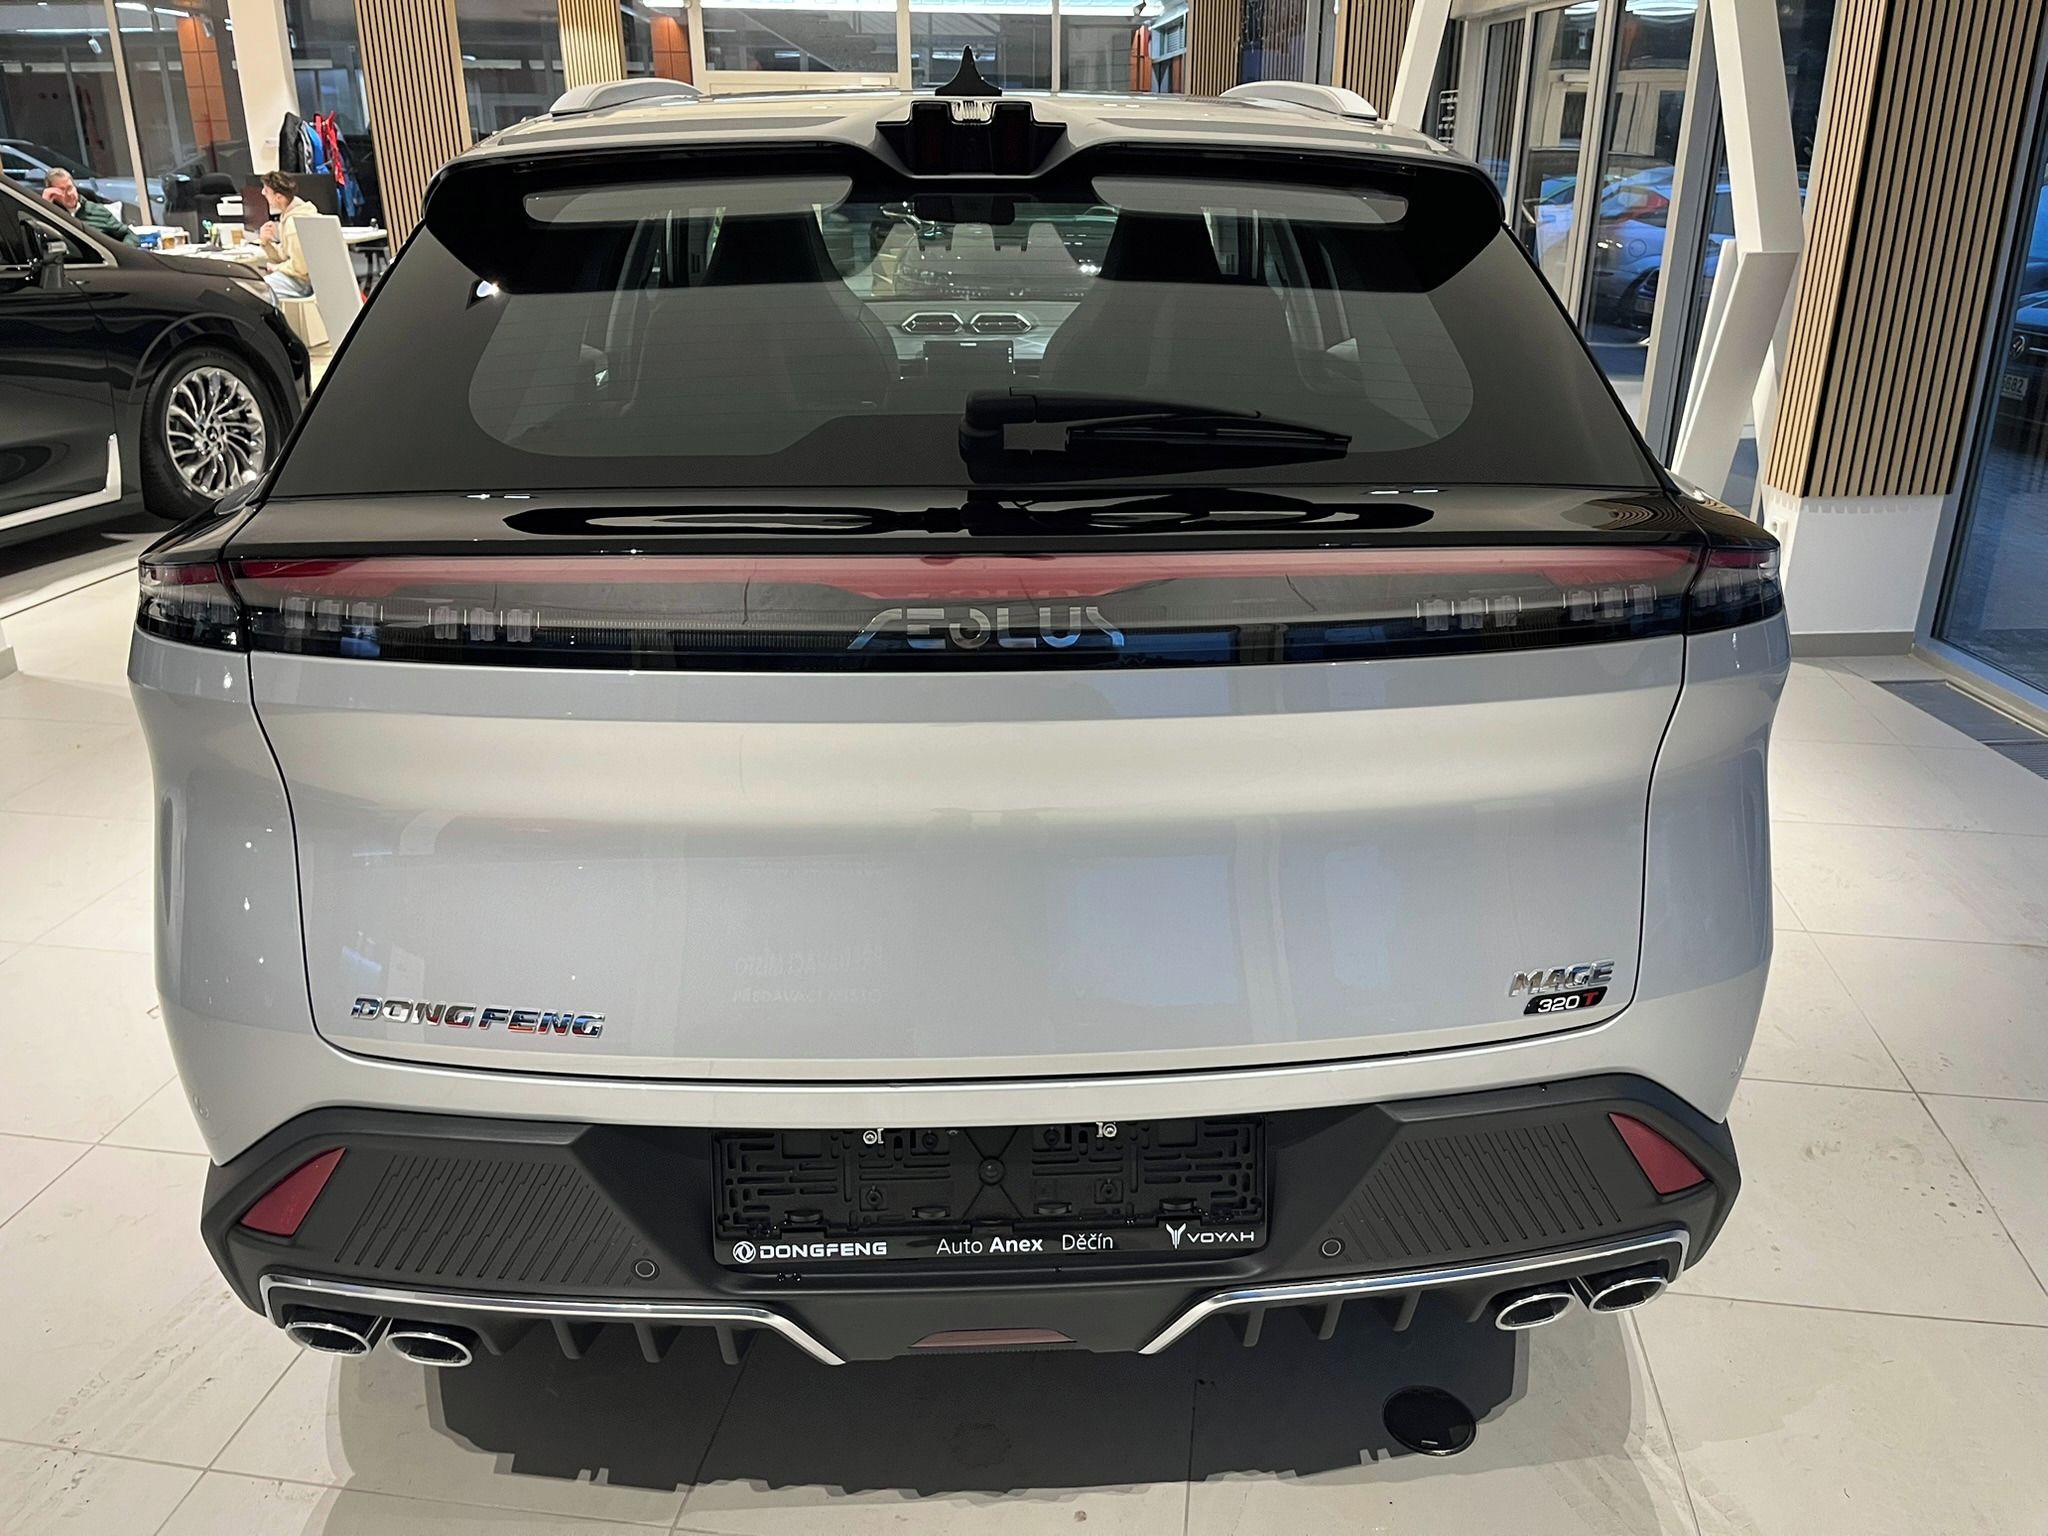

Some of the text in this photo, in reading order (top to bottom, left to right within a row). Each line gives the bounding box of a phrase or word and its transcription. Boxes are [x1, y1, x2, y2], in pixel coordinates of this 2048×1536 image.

[1508, 959, 1615, 997] MAGE
[350, 994, 606, 1038] DONGFENG
[936, 1232, 1113, 1255] Auto Anex Děčín
[1187, 1231, 1255, 1243] VOYAH
[759, 1241, 887, 1259] DONGFENG
